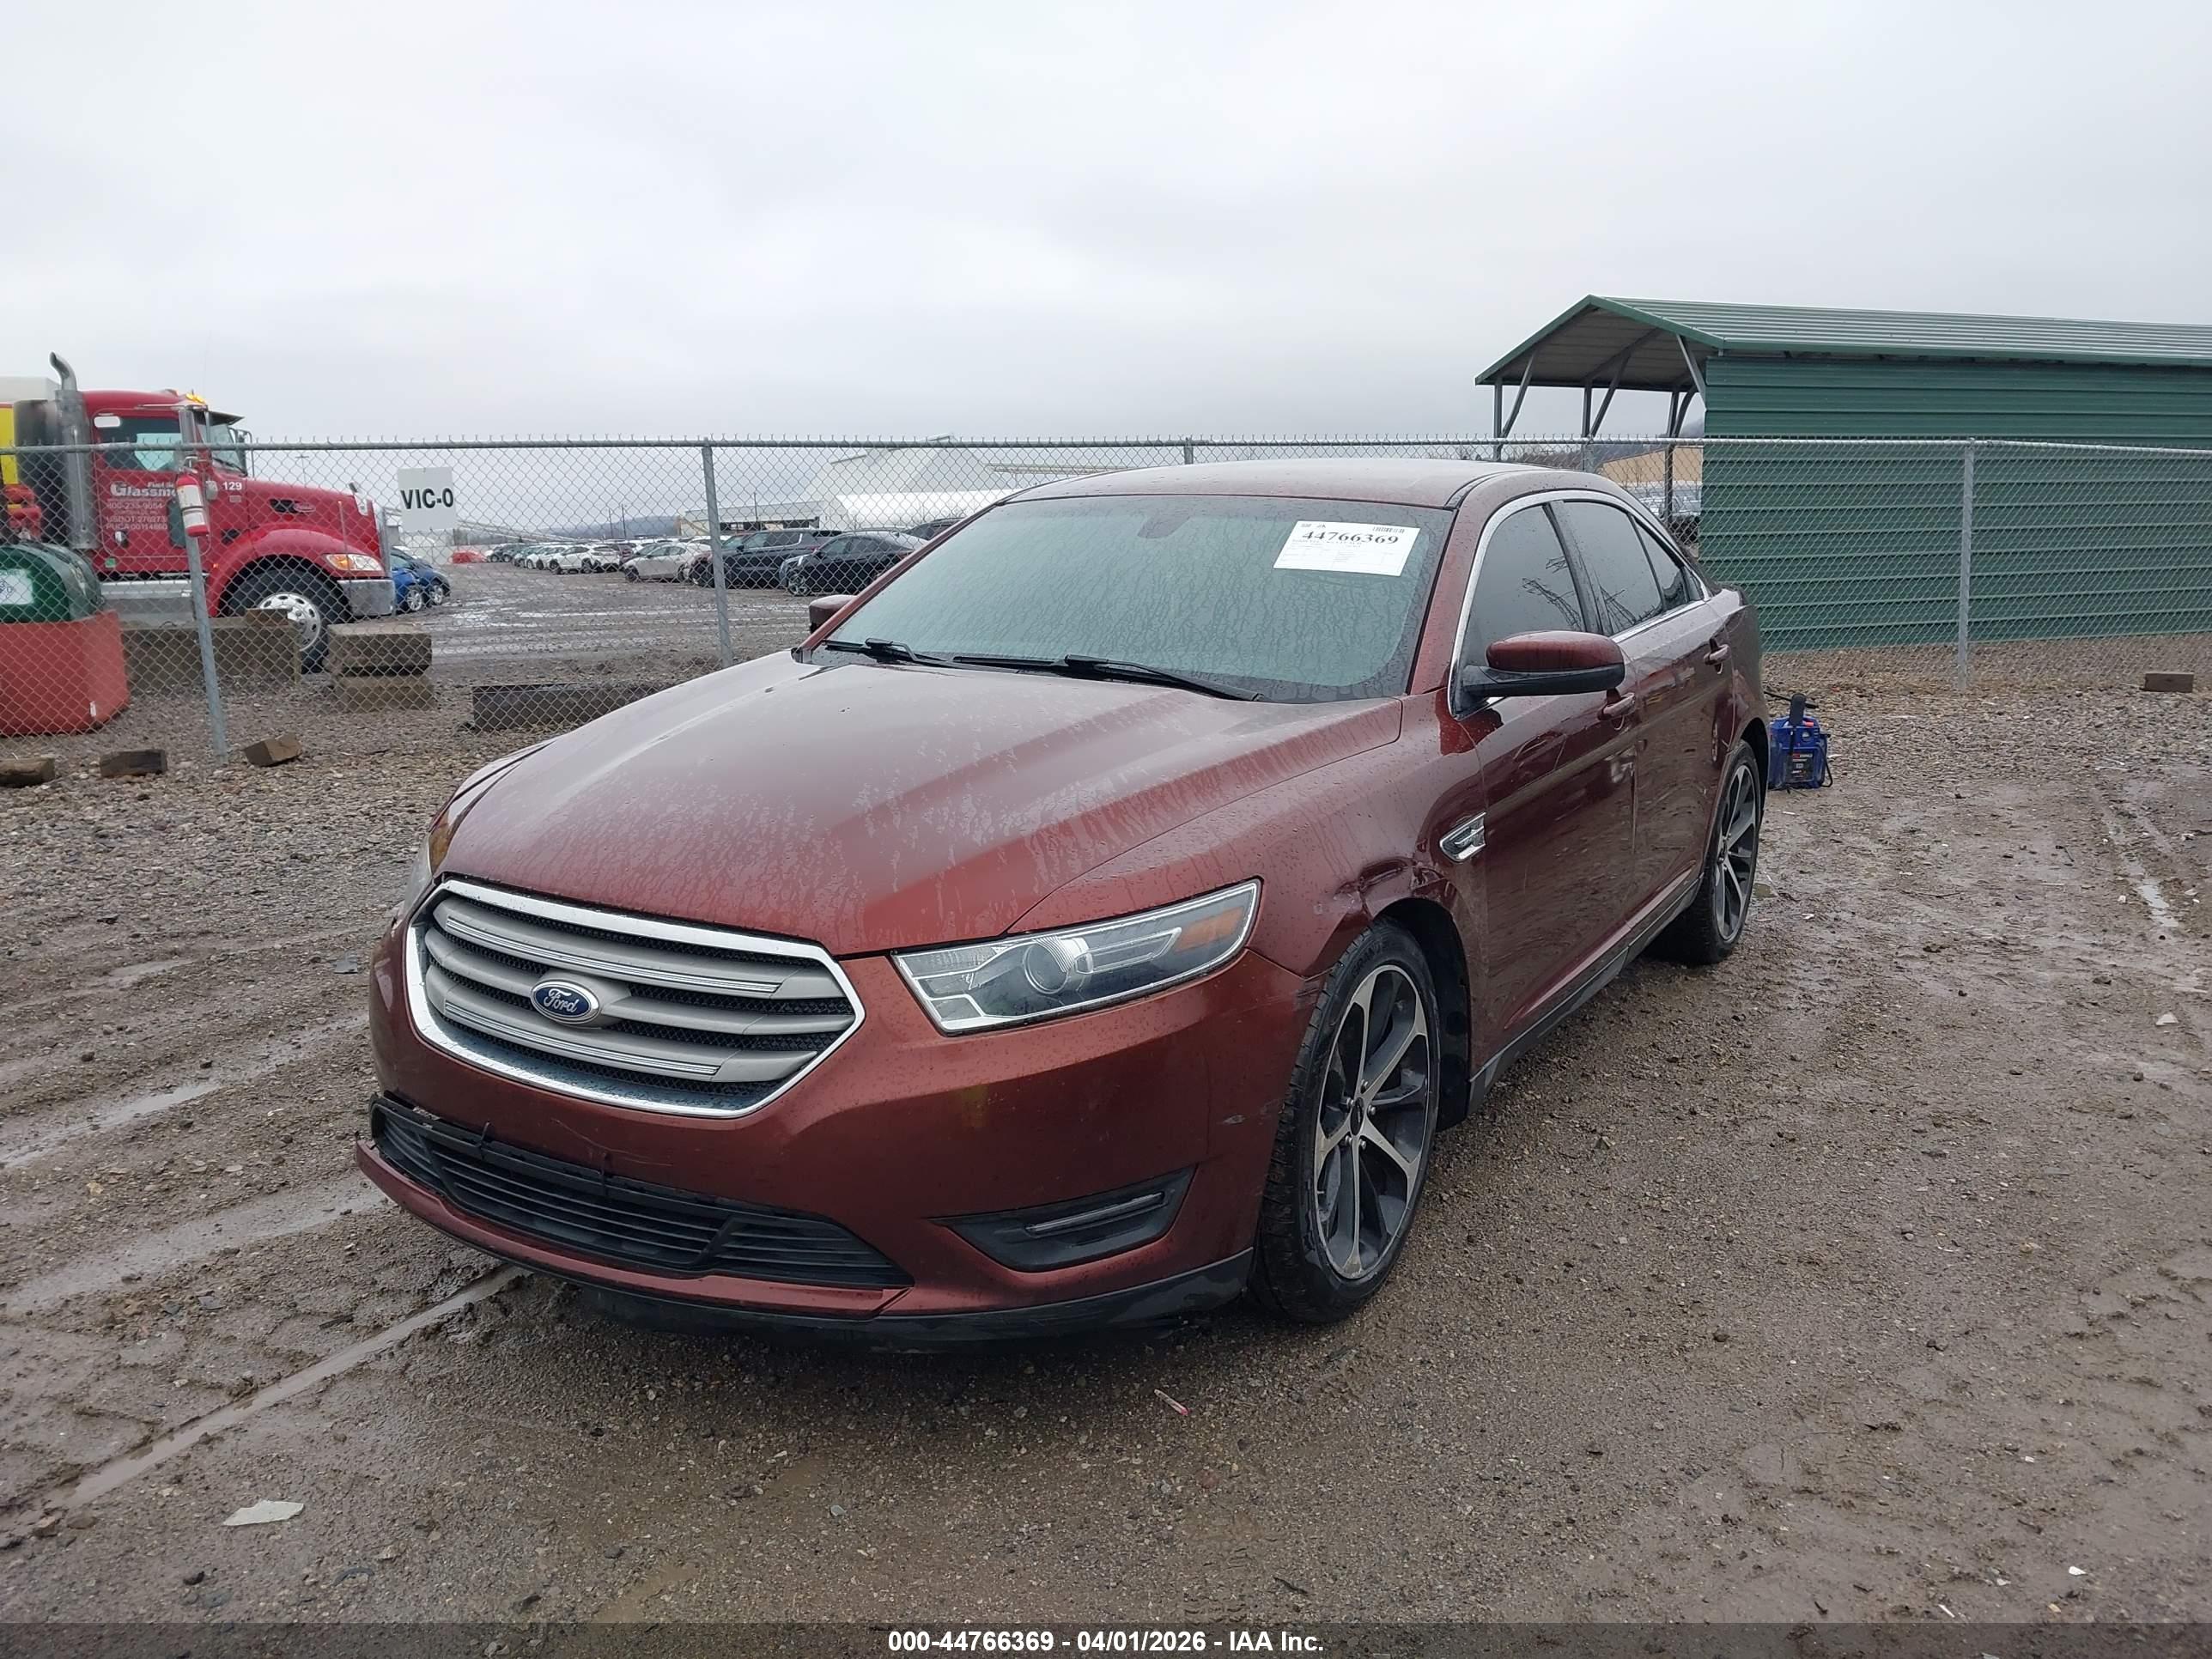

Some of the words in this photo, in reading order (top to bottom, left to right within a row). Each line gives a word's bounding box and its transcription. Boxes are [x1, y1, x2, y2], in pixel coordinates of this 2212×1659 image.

[223, 481, 242, 490] 129
[1302, 531, 1399, 544] 44766369
[543, 988, 580, 1013] Ford
